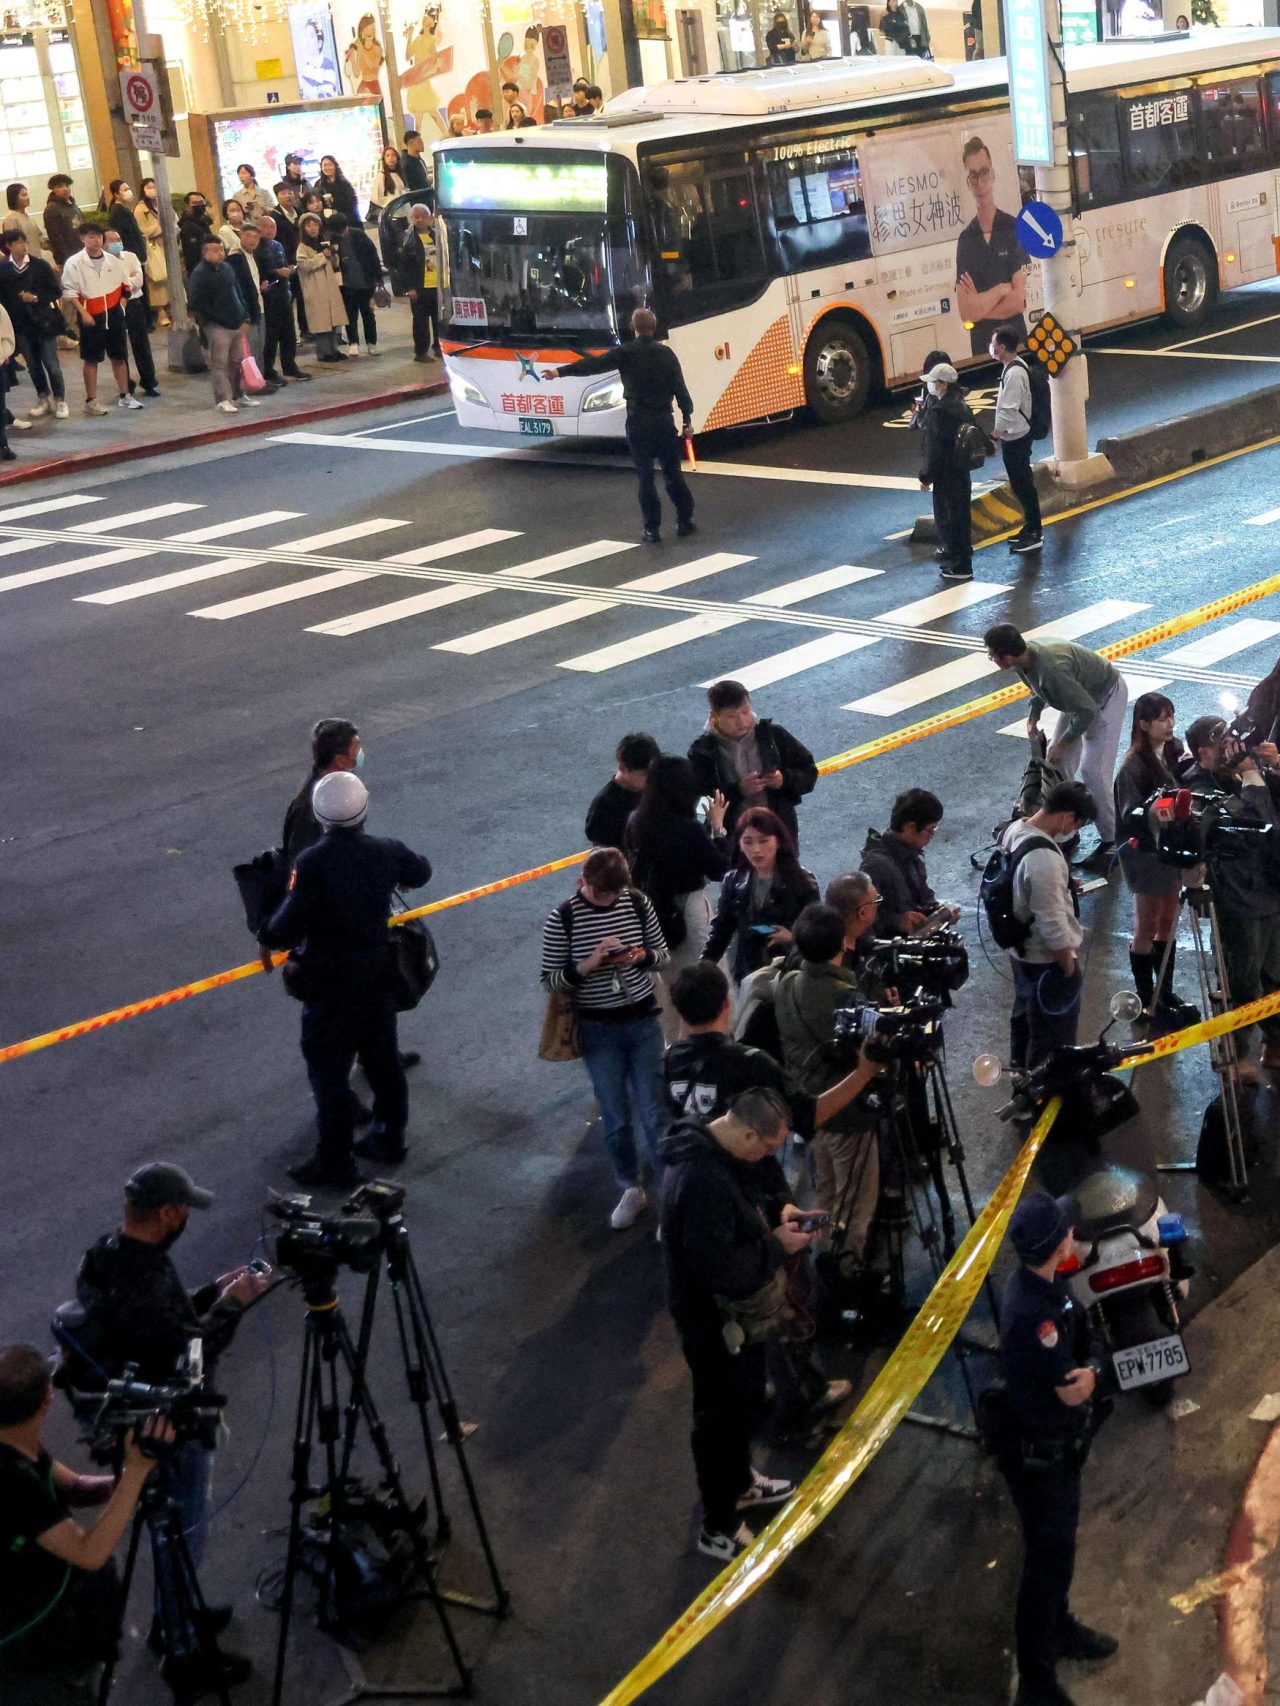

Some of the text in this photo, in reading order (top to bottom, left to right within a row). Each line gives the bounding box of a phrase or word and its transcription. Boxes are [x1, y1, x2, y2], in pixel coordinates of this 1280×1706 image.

[1129, 95, 1188, 131] 首都客運
[773, 136, 852, 161] 100% Electric
[501, 393, 565, 415] 首都客運
